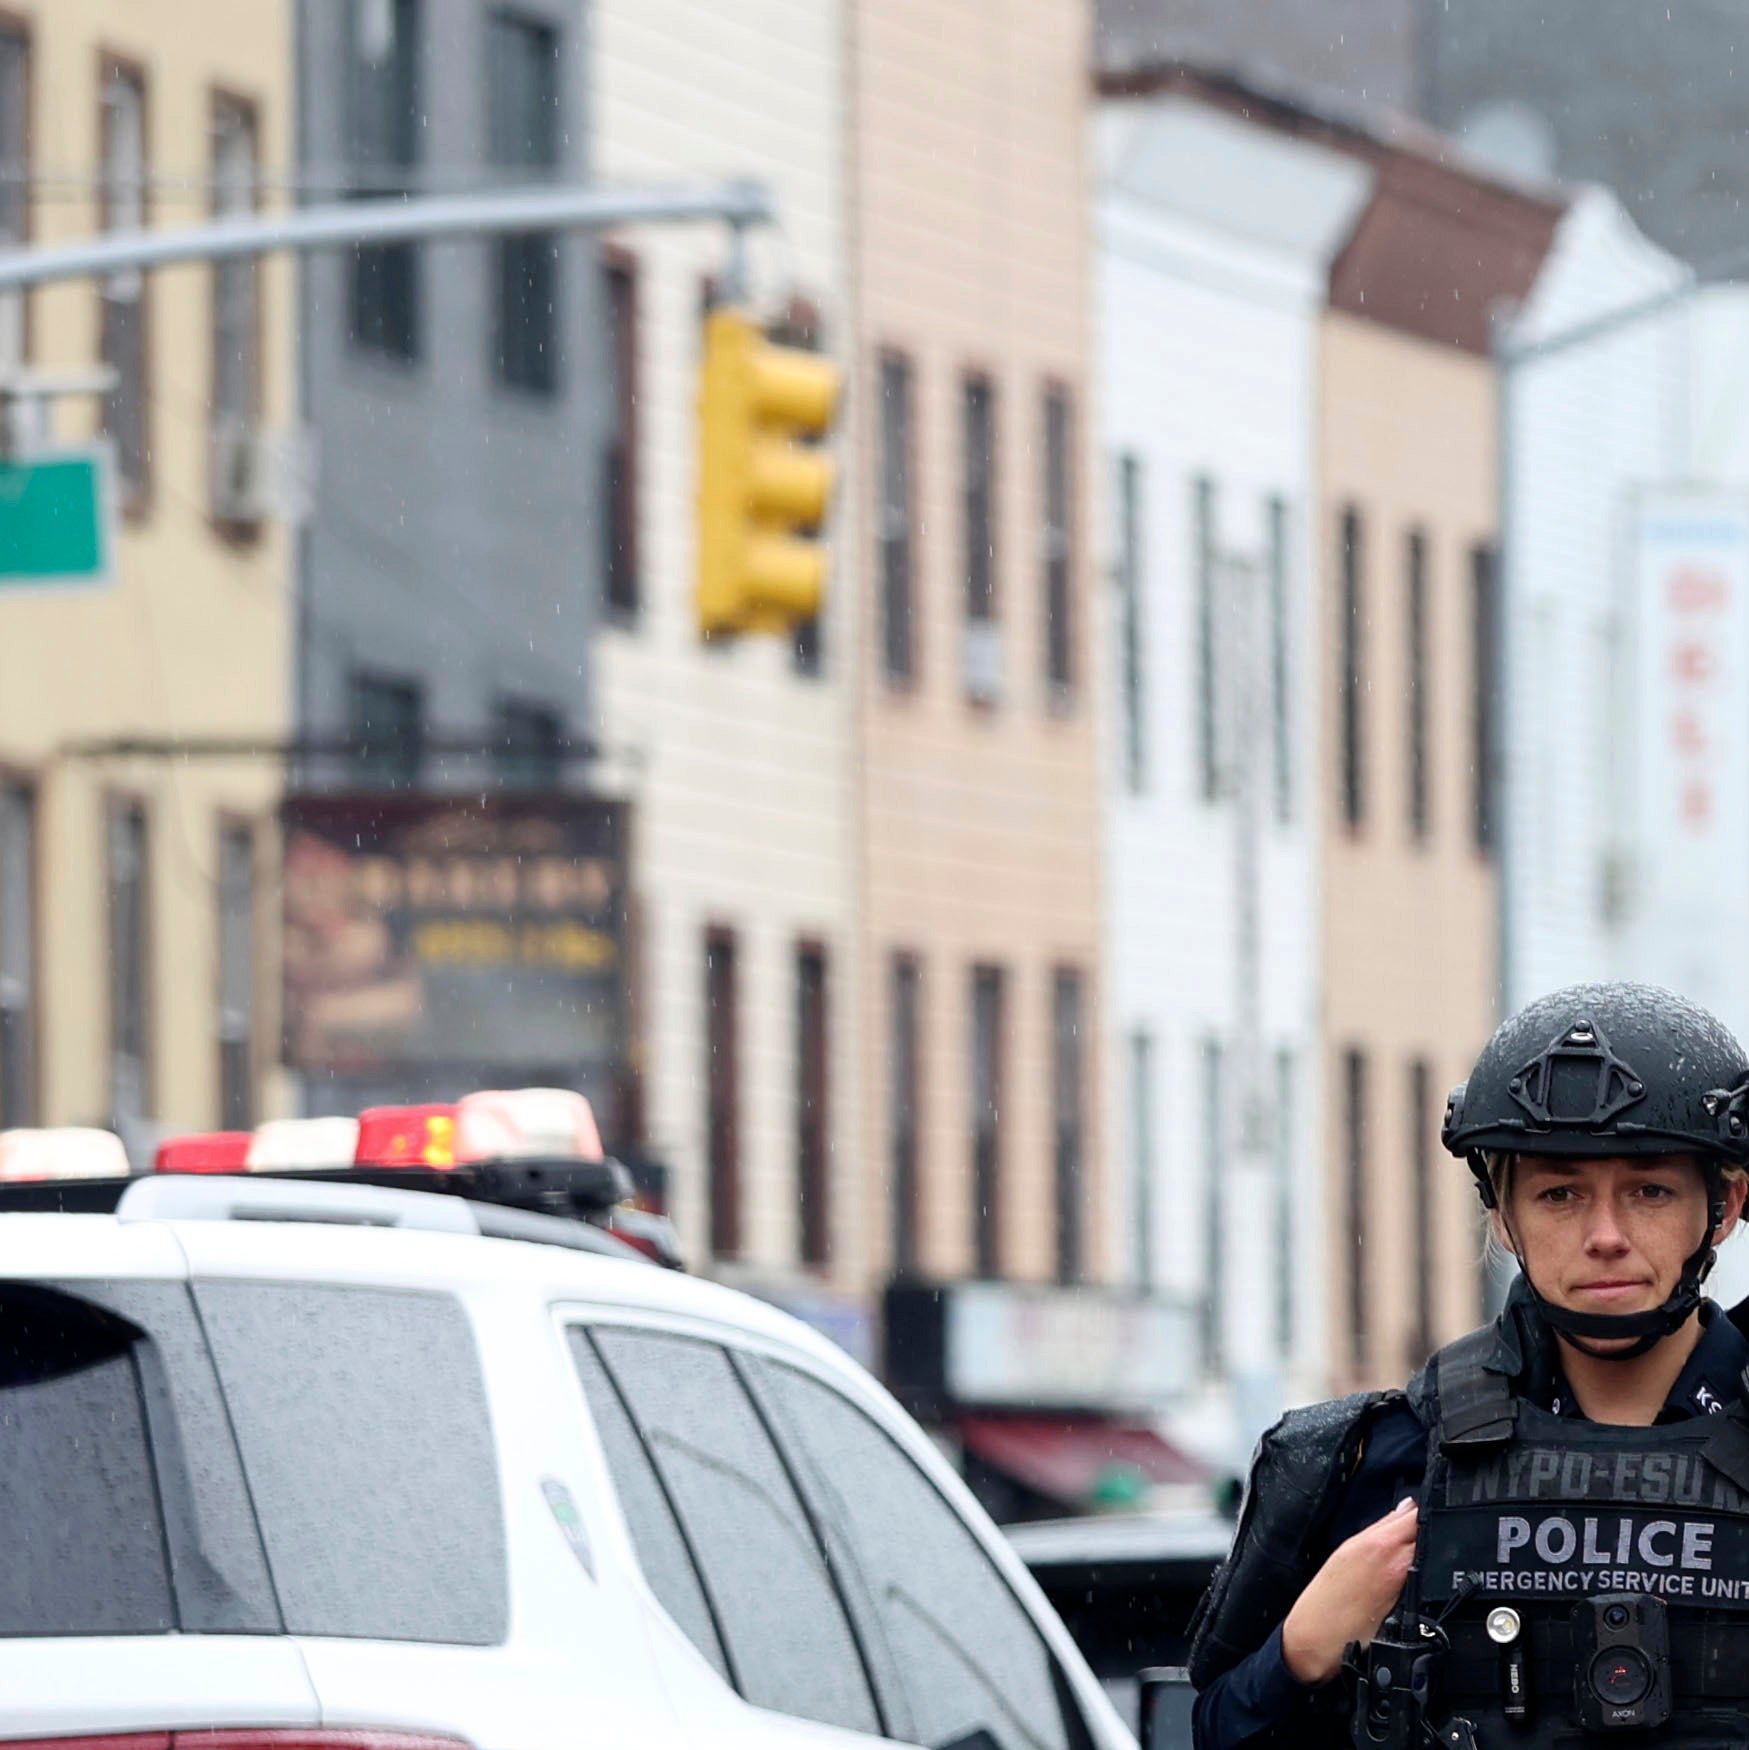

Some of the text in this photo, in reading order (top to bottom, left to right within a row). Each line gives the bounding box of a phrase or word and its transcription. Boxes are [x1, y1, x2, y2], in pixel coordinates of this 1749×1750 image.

[1496, 1516, 1715, 1570] POLICE
[1452, 1570, 1595, 1593] EERGENCY
[1597, 1570, 1694, 1596] SERVICE
[1510, 1663, 1519, 1694] NEBO
